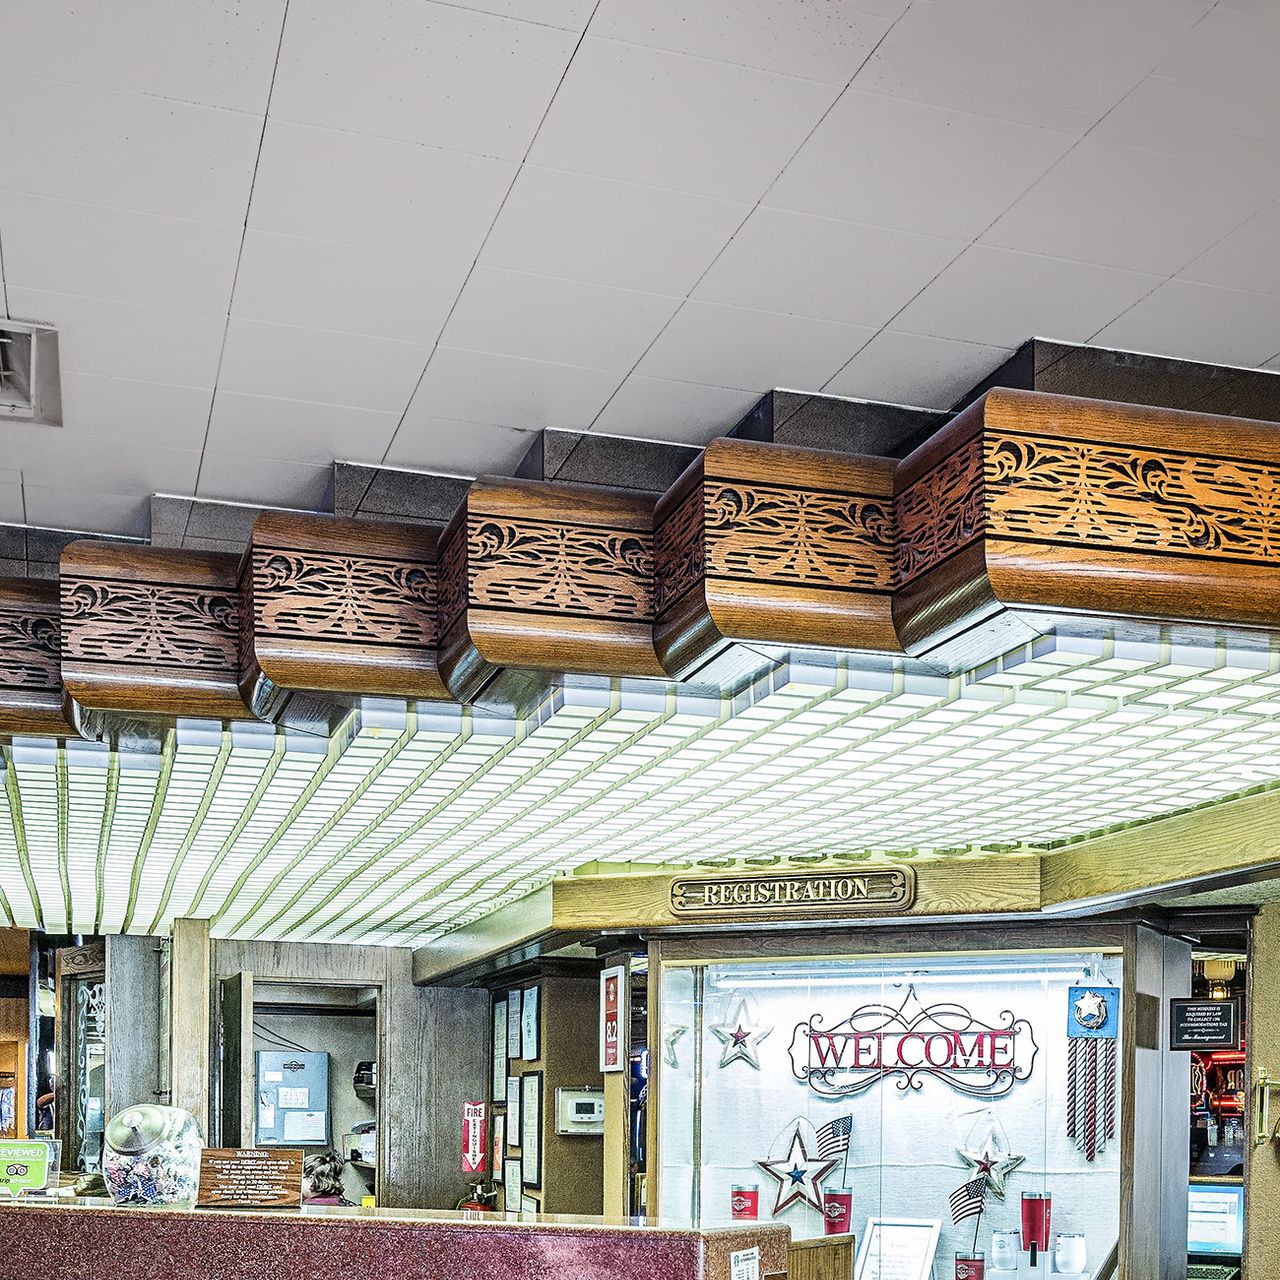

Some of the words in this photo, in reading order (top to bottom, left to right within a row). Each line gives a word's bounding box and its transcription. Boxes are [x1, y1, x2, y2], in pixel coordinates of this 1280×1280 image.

[703, 878, 870, 905] REGISTRATION
[811, 1031, 1014, 1070] WELCOME
[467, 1108, 483, 1117] FIRE
